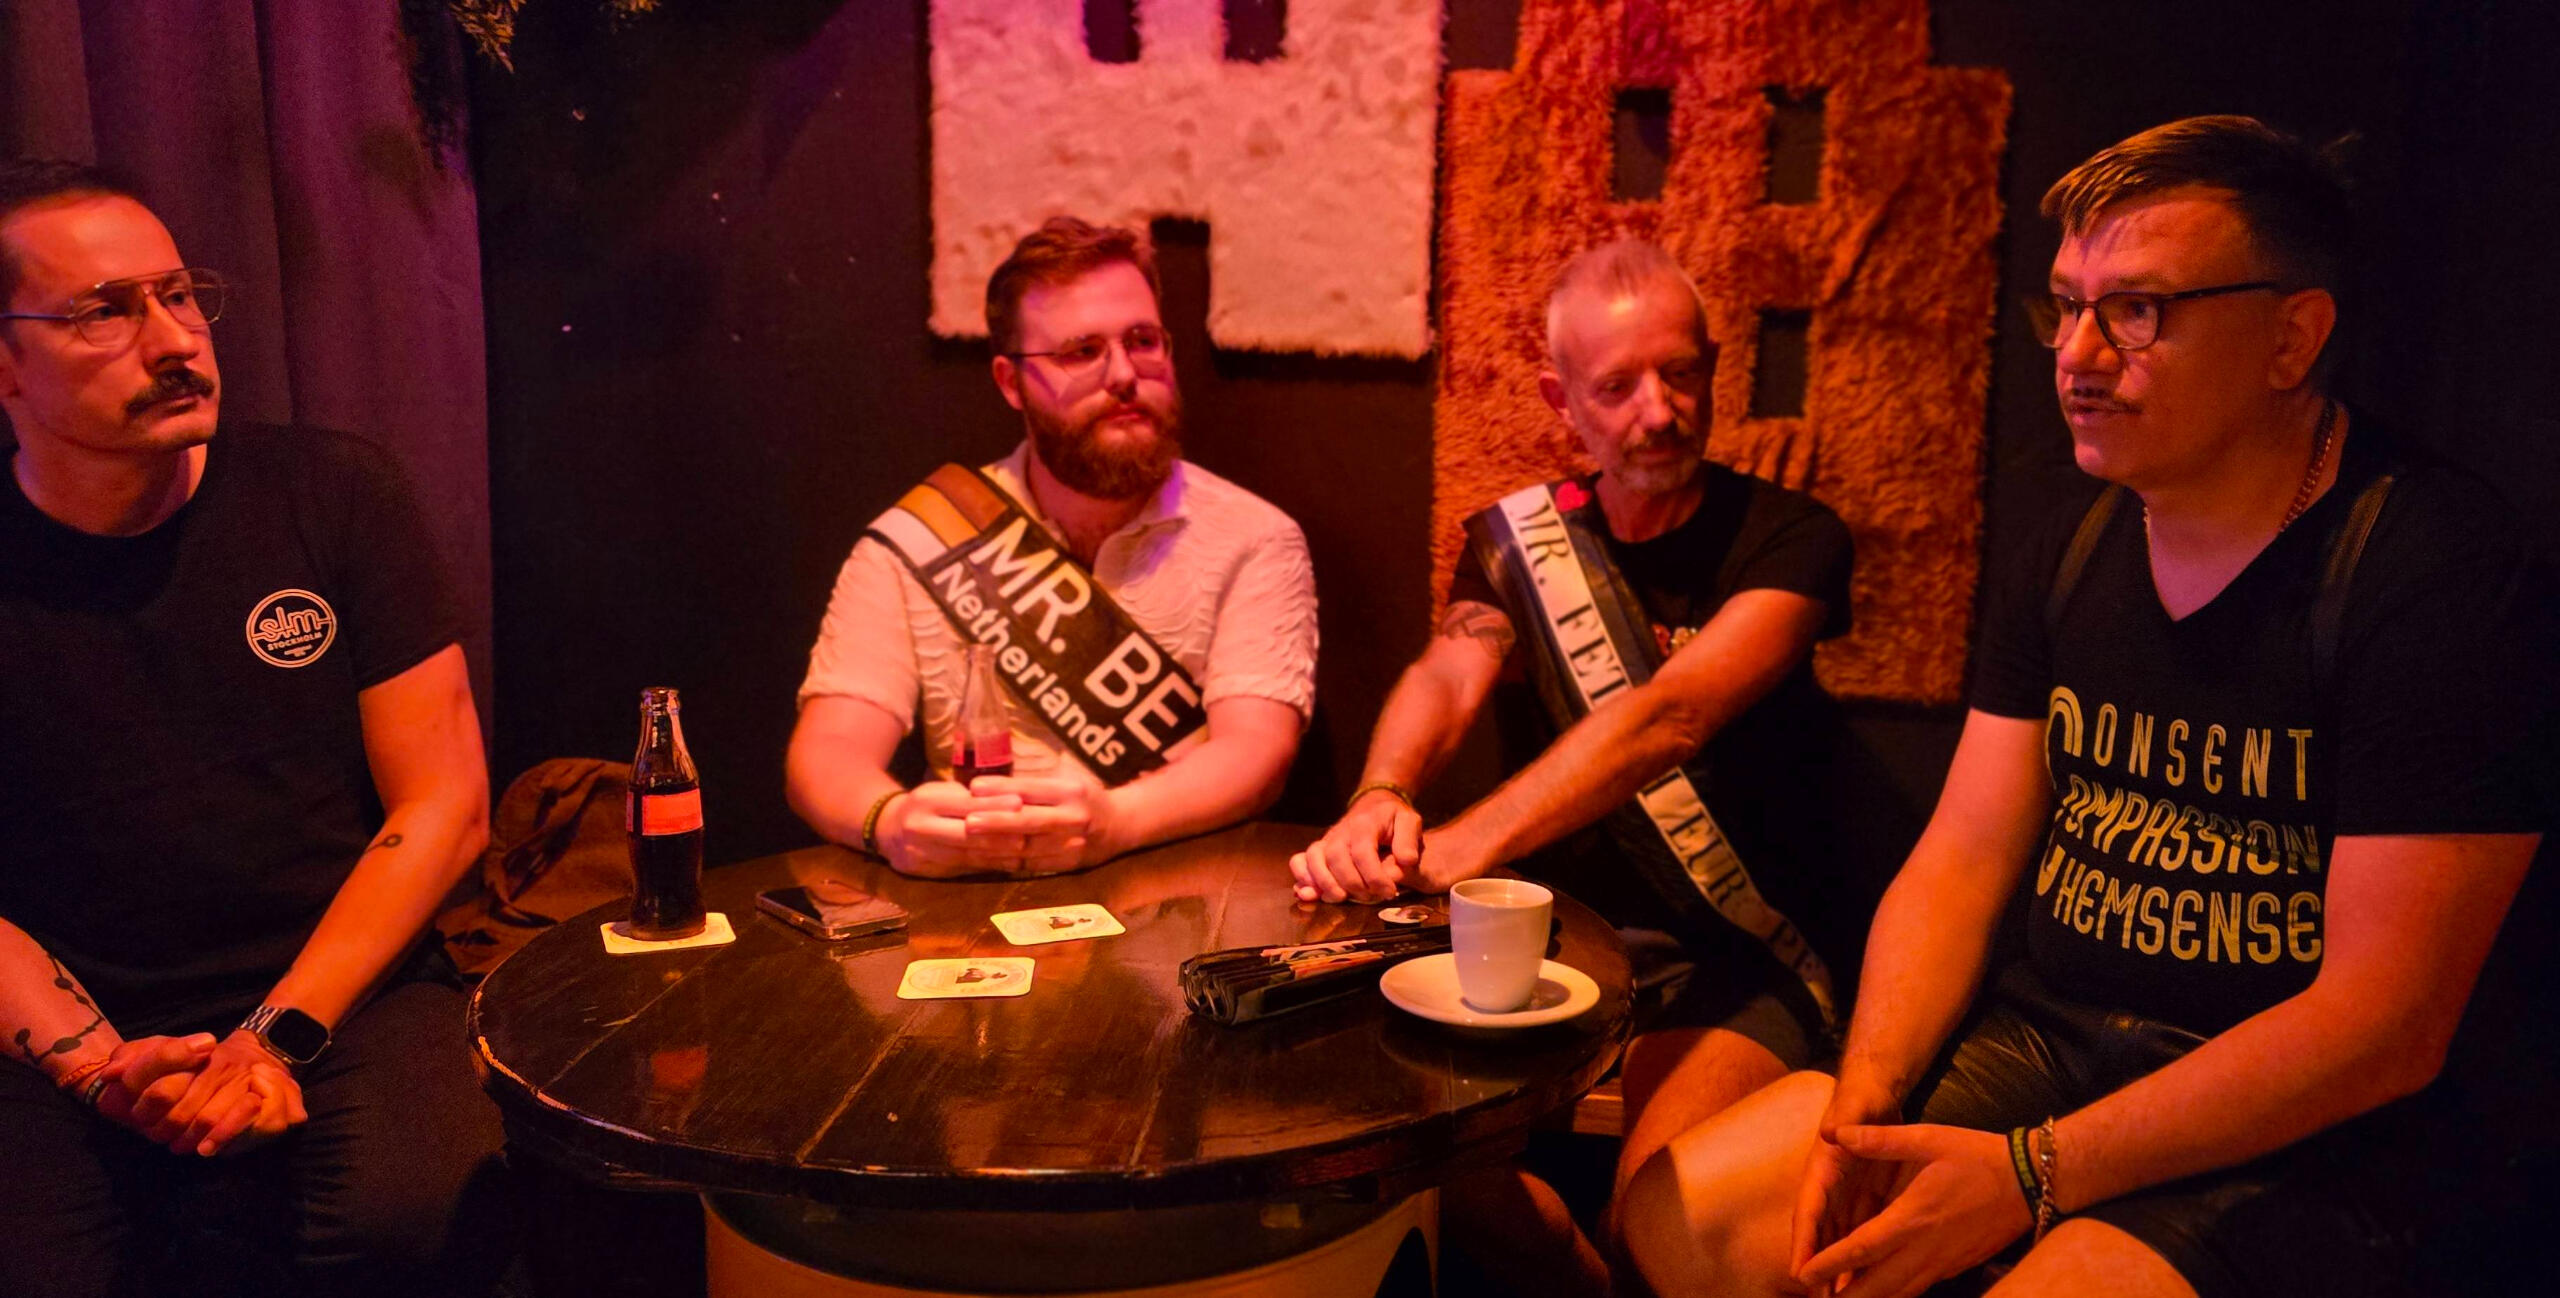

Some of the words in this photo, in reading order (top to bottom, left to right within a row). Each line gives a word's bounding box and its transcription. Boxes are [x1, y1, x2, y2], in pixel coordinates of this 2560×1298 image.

[967, 516, 1094, 654] MR.
[1511, 499, 1570, 587] MR.
[267, 631, 324, 652] STOCKHOLM
[932, 562, 1126, 766] Netherlands
